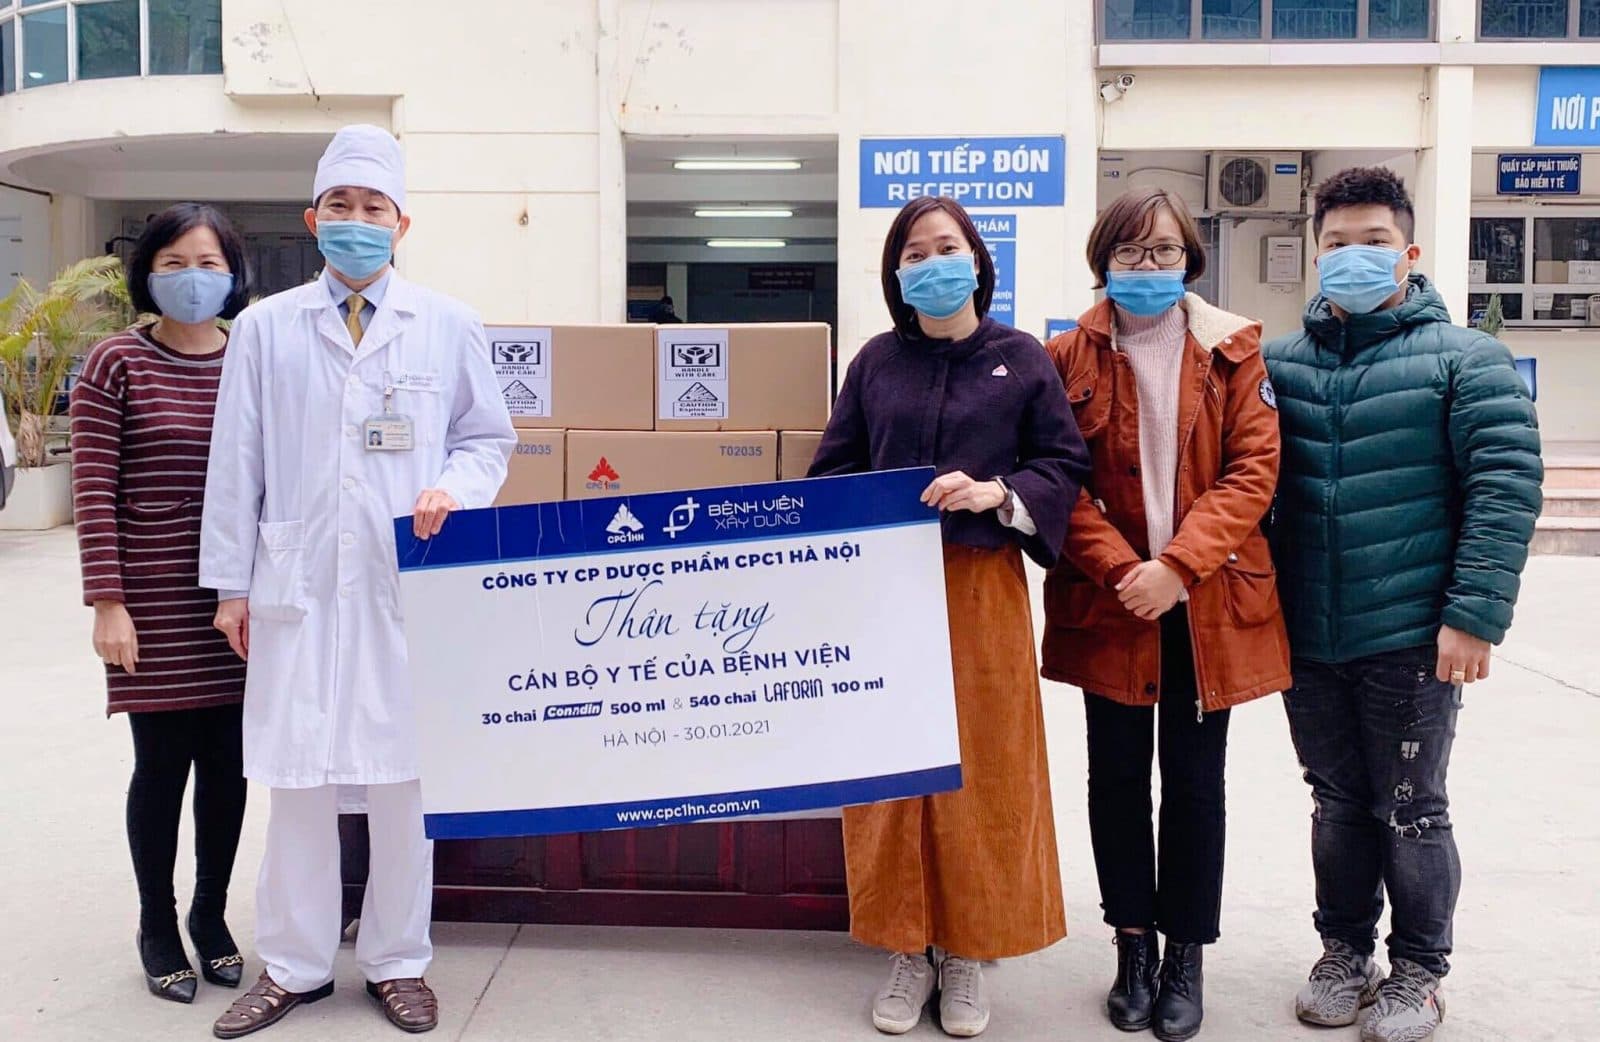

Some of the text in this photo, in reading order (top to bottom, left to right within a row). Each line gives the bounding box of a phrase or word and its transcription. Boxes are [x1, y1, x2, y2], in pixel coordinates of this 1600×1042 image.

[1551, 93, 1586, 130] NƠI
[874, 143, 1049, 175] NƠI TIẾP ĐÓN
[888, 182, 1034, 200] RECEPTION
[1550, 177, 1555, 189] Y
[514, 444, 552, 455] 02035
[719, 445, 763, 457] T02035
[714, 514, 749, 530] XÂY
[607, 530, 645, 544] CPC1HN
[482, 571, 537, 590] CÔNG
[543, 570, 568, 585] TY
[574, 568, 600, 582] CP
[606, 561, 665, 582] DƯỢC
[735, 551, 783, 568] CPC1
[789, 545, 818, 563] HÀ
[824, 541, 861, 563] NỘI
[574, 579, 775, 654] Thân tặng
[508, 643, 851, 691] CÁN BỘ Y TẾ CỦA BỆNH VIỆN
[482, 712, 501, 725] 30
[505, 709, 537, 723] chai
[610, 701, 642, 715] 500
[645, 699, 666, 713] ml
[672, 697, 683, 710] &
[689, 694, 720, 708] 540
[724, 690, 757, 705] chai
[764, 679, 824, 702] LAFORIN
[831, 680, 860, 693] 100
[864, 677, 884, 690] ml
[603, 730, 629, 748] HÀ
[634, 728, 667, 746] NỘI
[684, 720, 770, 741] 30.01.2021
[616, 799, 760, 822] www.cpc1hn.com.vn
